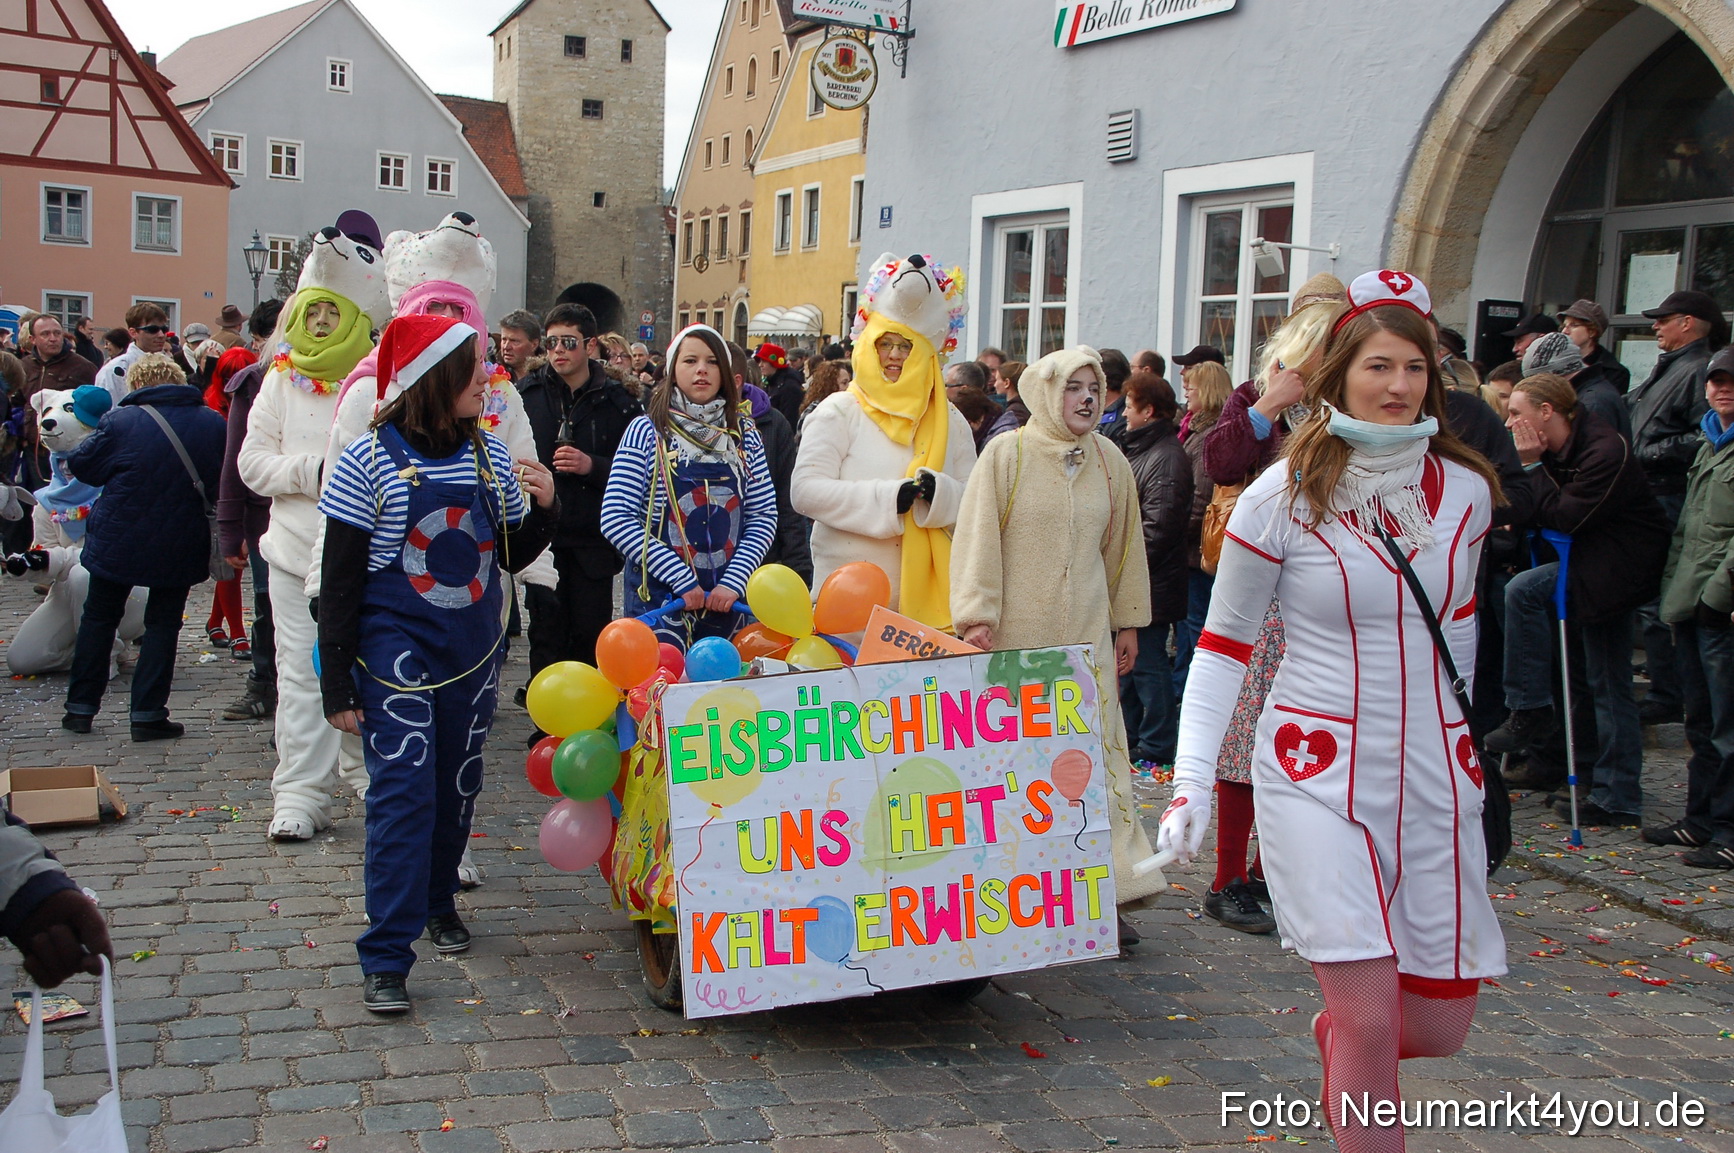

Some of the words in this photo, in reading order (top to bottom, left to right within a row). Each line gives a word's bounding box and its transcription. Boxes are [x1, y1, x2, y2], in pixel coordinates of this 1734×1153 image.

[800, 2, 844, 16] Roma
[828, 0, 867, 10] Bella
[1082, 0, 1131, 34] Bella
[1138, 0, 1199, 21] Roma
[828, 91, 858, 102] BERCHING
[737, 809, 851, 874] UNS
[888, 772, 1054, 853] HAT'S
[692, 908, 819, 973] KALT
